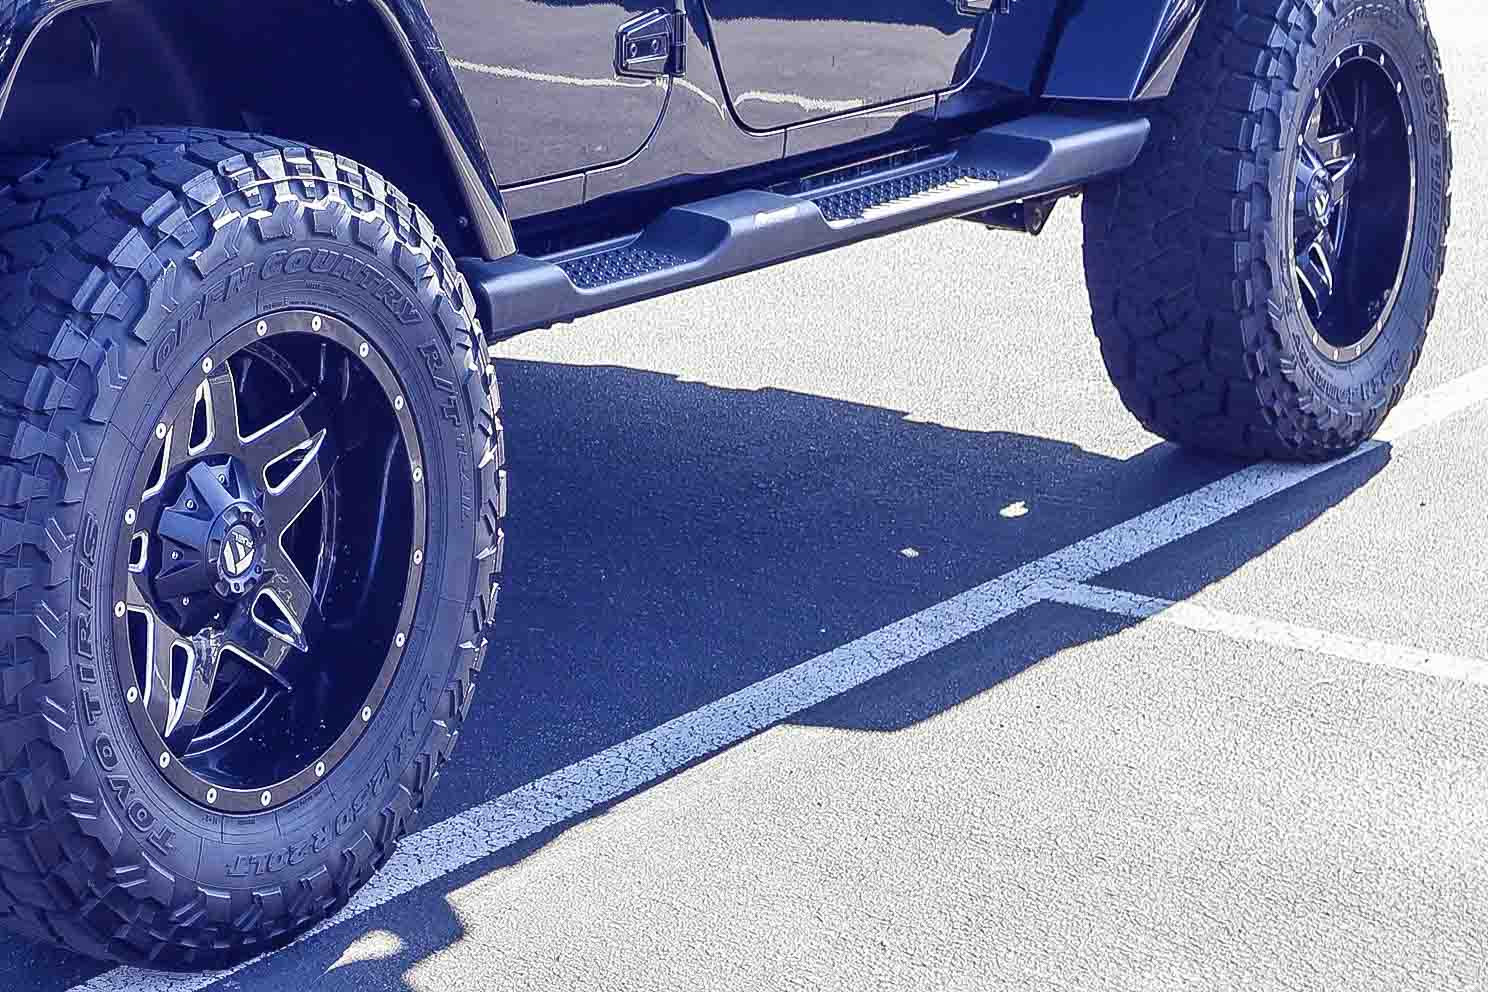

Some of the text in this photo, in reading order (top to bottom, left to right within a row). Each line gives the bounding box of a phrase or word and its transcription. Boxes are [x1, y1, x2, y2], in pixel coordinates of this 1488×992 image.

[155, 261, 256, 372] OPEN
[261, 247, 424, 325] COUNTRY
[417, 338, 462, 428] R/T
[77, 511, 177, 856] TOYO TIRES
